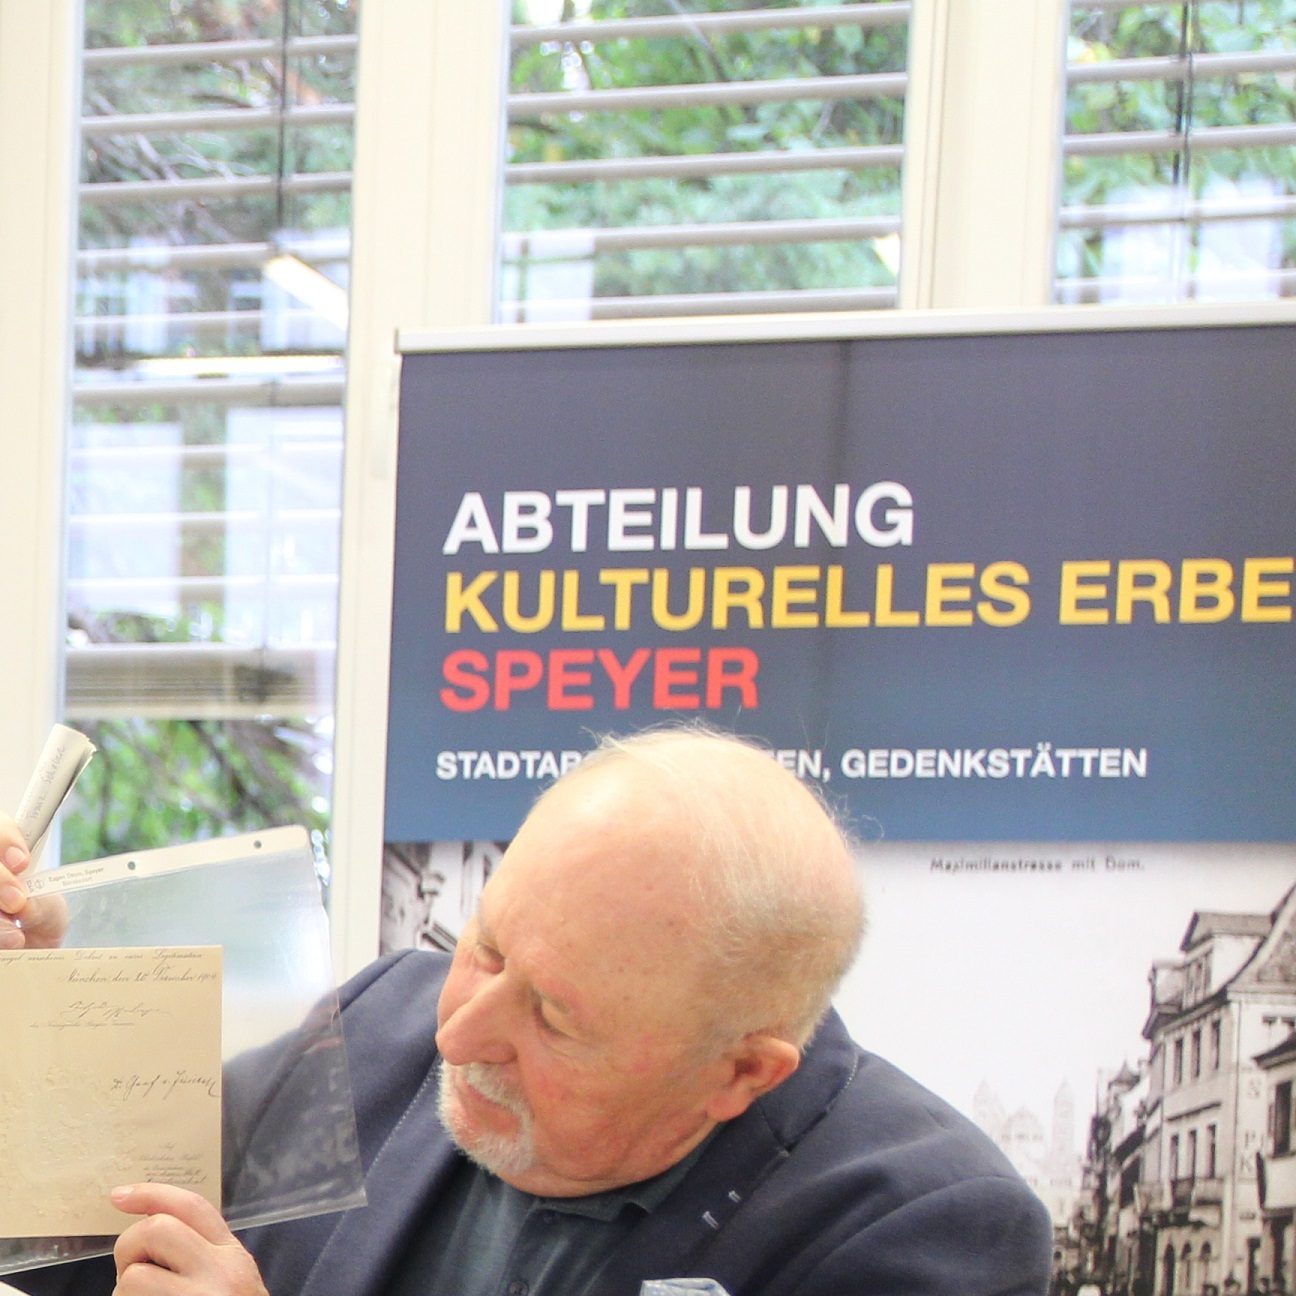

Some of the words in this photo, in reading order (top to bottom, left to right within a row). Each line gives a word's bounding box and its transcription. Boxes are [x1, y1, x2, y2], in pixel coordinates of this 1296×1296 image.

[442, 481, 915, 556] ABTEILUNG
[444, 561, 1031, 633] KULTURELLES
[1058, 556, 1293, 624] ERBE
[439, 646, 759, 712] SPEYER
[841, 742, 1148, 779] GEDENKSTÄTTEN
[1071, 857, 1096, 872] mit
